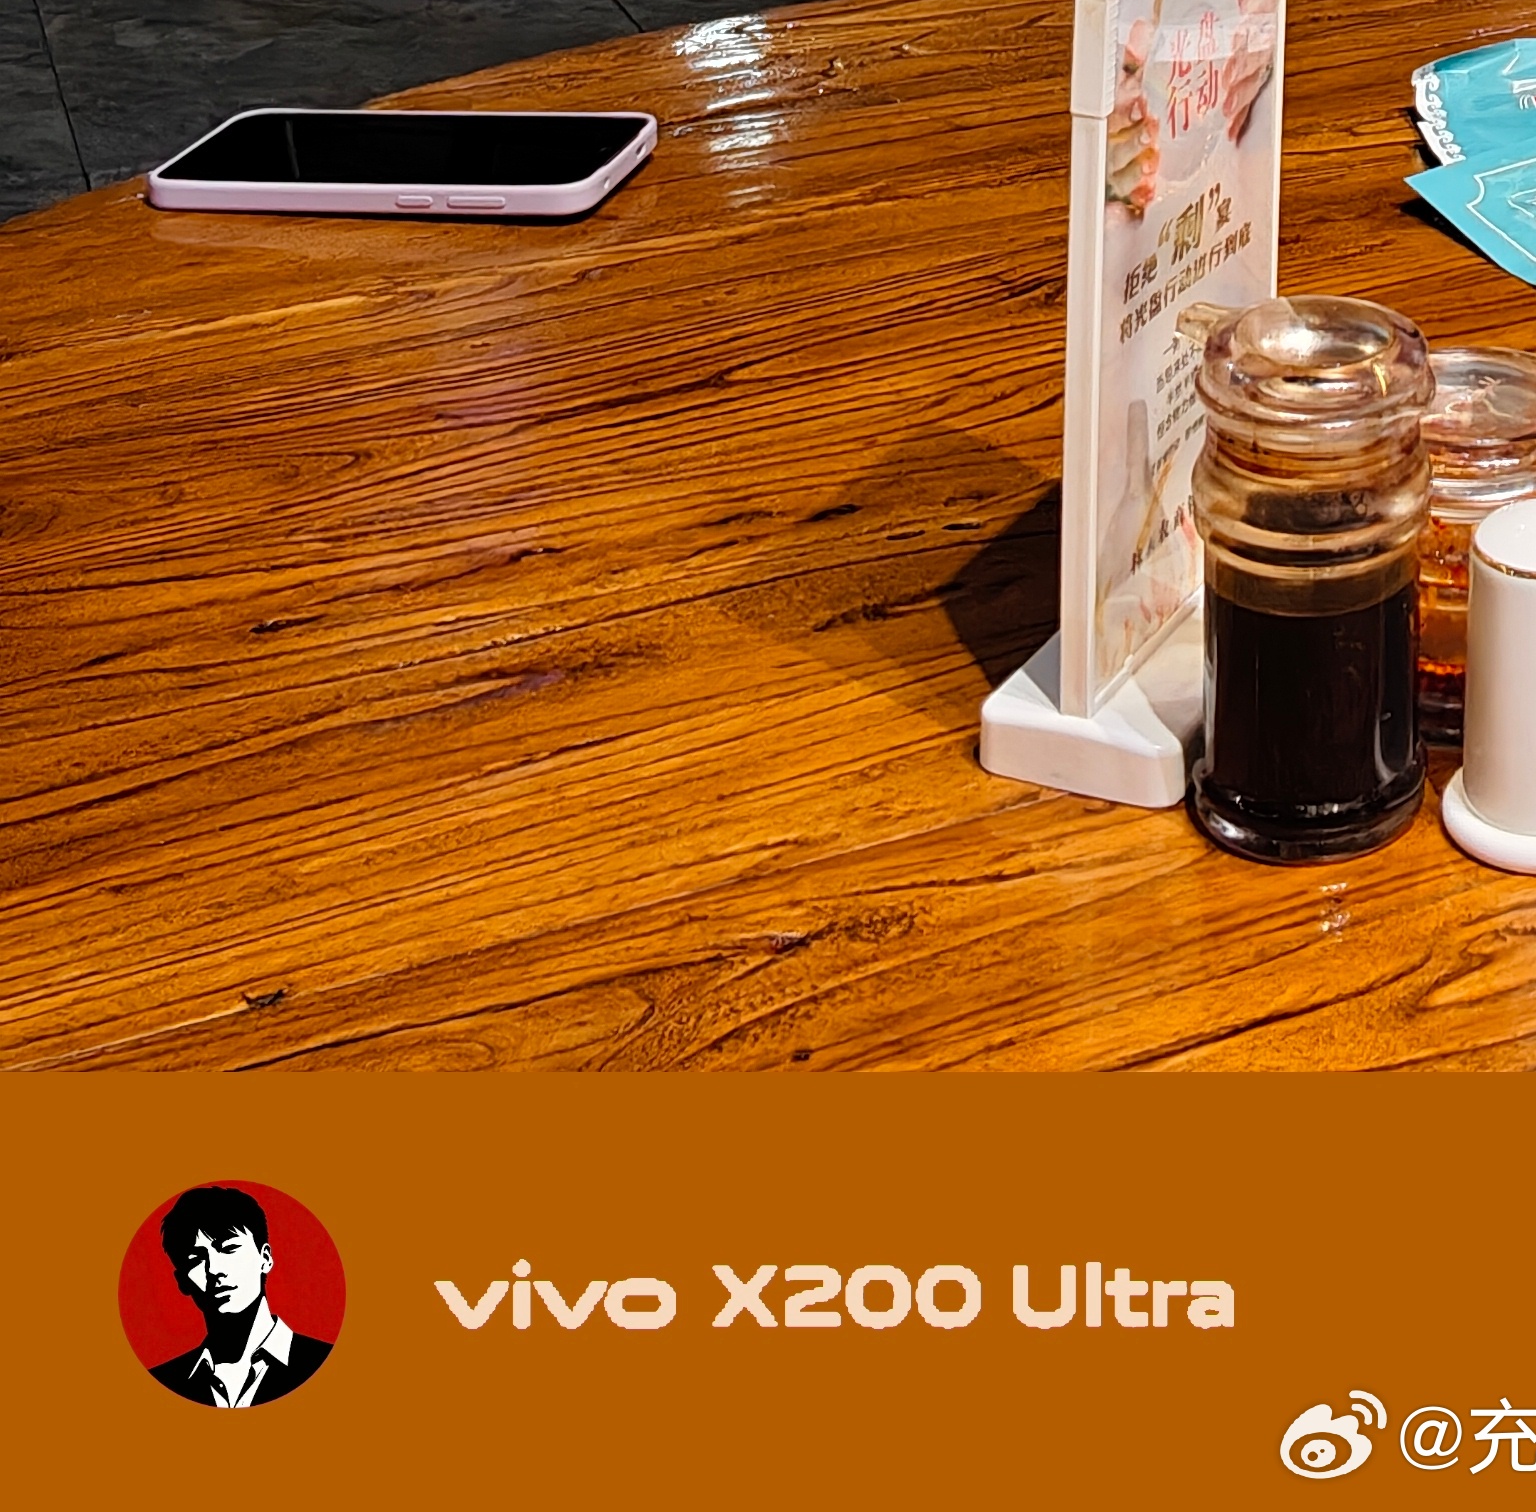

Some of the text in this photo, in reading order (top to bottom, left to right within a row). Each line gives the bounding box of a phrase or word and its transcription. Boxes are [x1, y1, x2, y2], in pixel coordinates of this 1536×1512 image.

[1118, 221, 1253, 344] 将光盘行动进行到底
